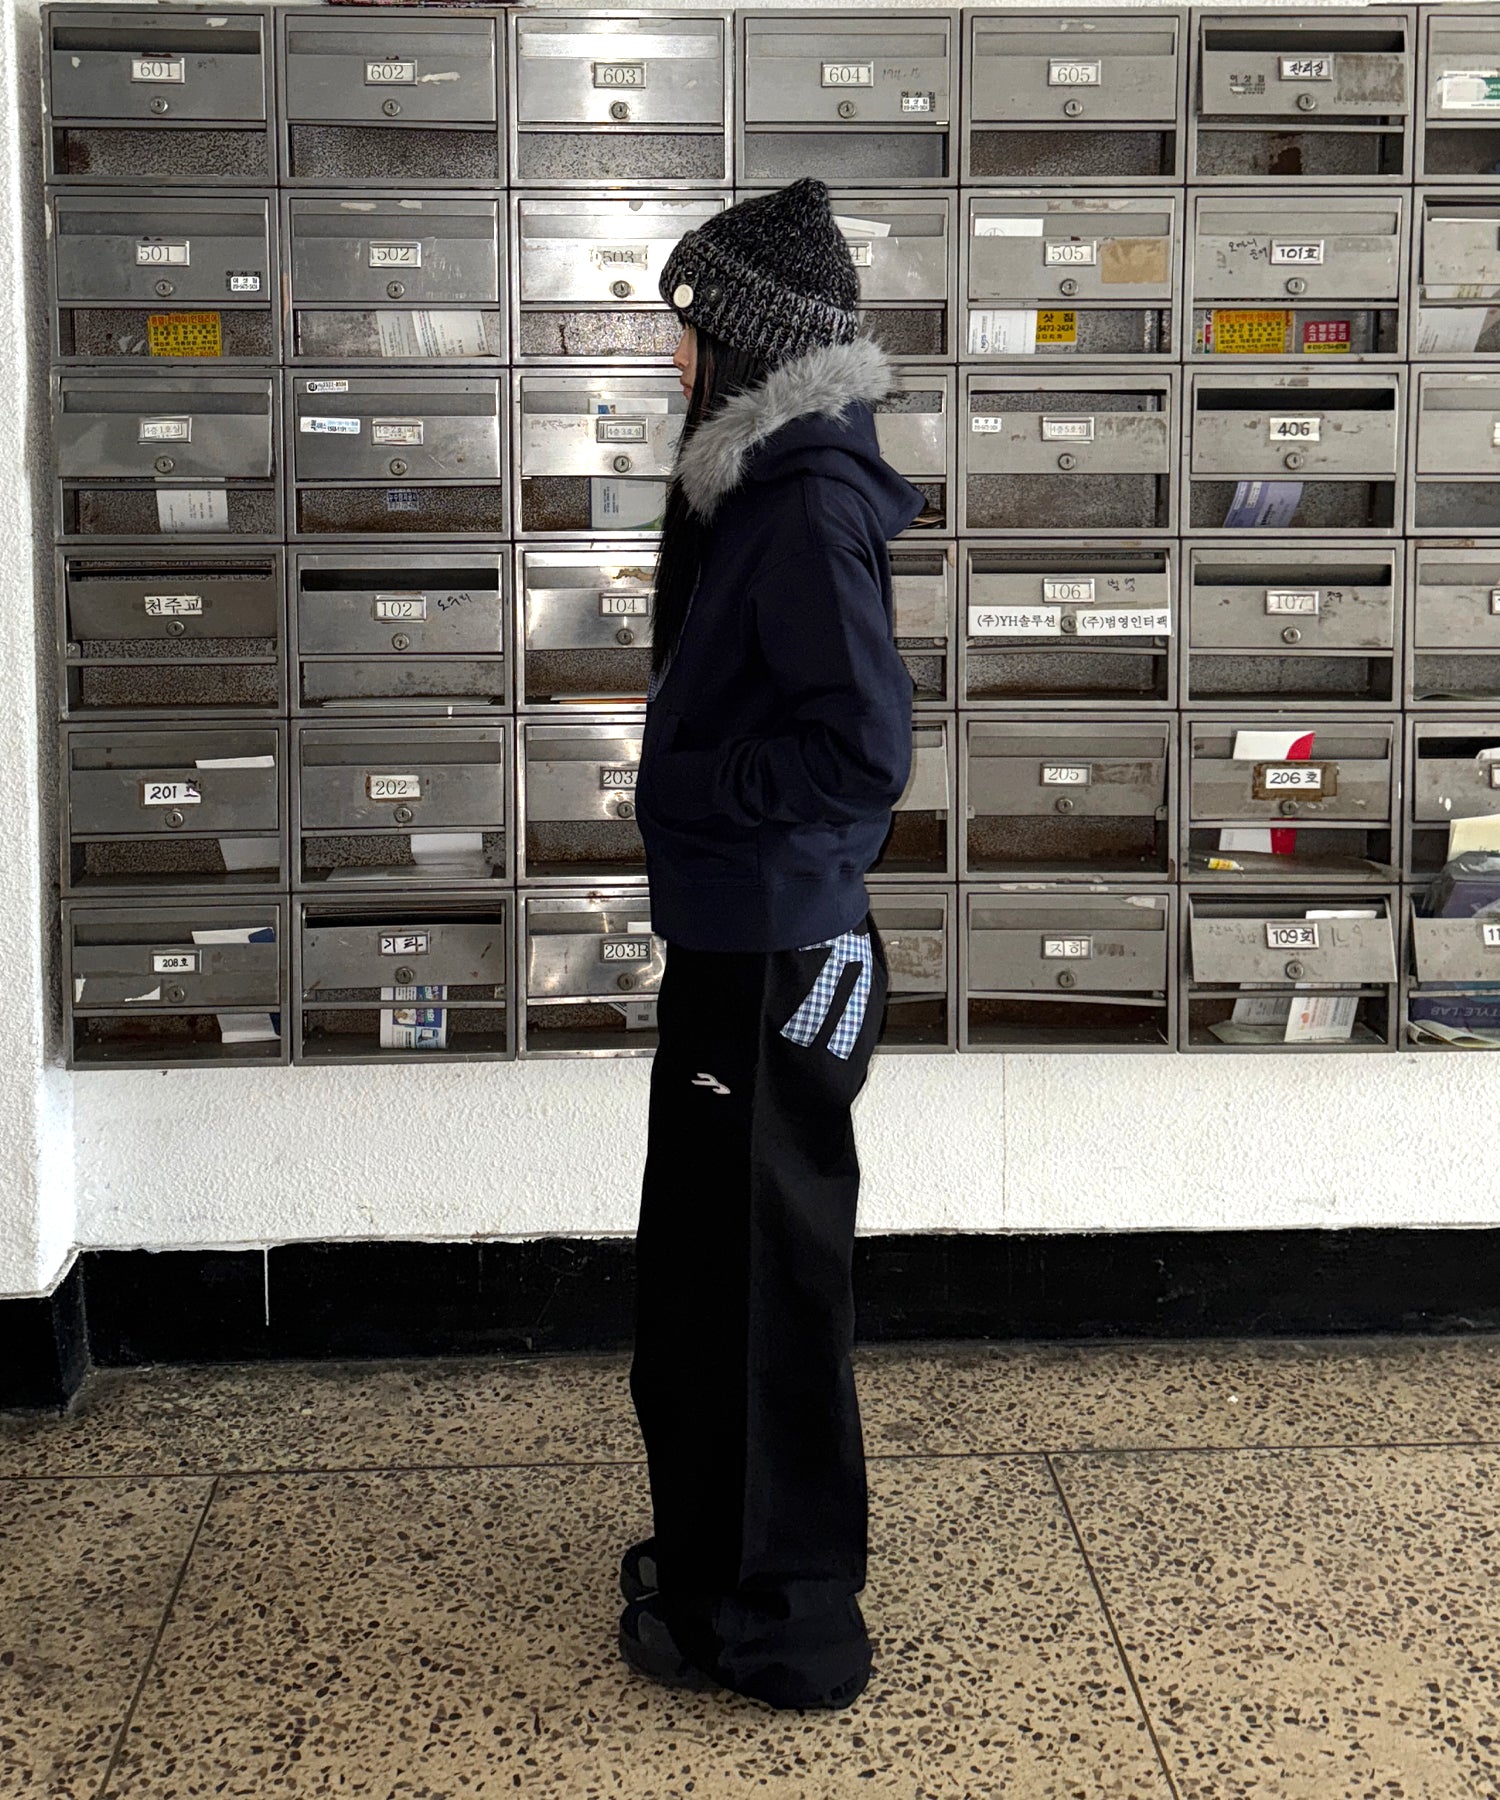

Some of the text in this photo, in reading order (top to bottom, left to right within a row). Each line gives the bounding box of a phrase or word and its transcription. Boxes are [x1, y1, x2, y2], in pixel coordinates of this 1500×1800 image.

[141, 63, 172, 77] 601
[371, 64, 404, 80] 602
[604, 68, 635, 84] 603
[830, 67, 860, 82] 604
[1058, 68, 1090, 83] 605
[140, 245, 171, 262] 501
[378, 247, 409, 261] 502
[603, 250, 634, 265] 503
[1052, 246, 1084, 261] 505
[1278, 422, 1310, 436] 406
[1052, 584, 1081, 599] 106
[146, 598, 199, 615] 천주교
[382, 602, 413, 617] 102
[607, 599, 637, 613] 104
[1276, 595, 1305, 609] 107
[977, 614, 1056, 628] (주)YH솔루션
[1082, 615, 1168, 629] (주)범영인터팩
[604, 771, 638, 785] 203
[1048, 768, 1079, 781] 205
[1270, 771, 1301, 784] 206
[150, 785, 177, 800] 201
[375, 780, 408, 795] 202
[384, 937, 424, 953] 기타
[605, 943, 649, 958] 203B
[1431, 1006, 1459, 1017] LAB
